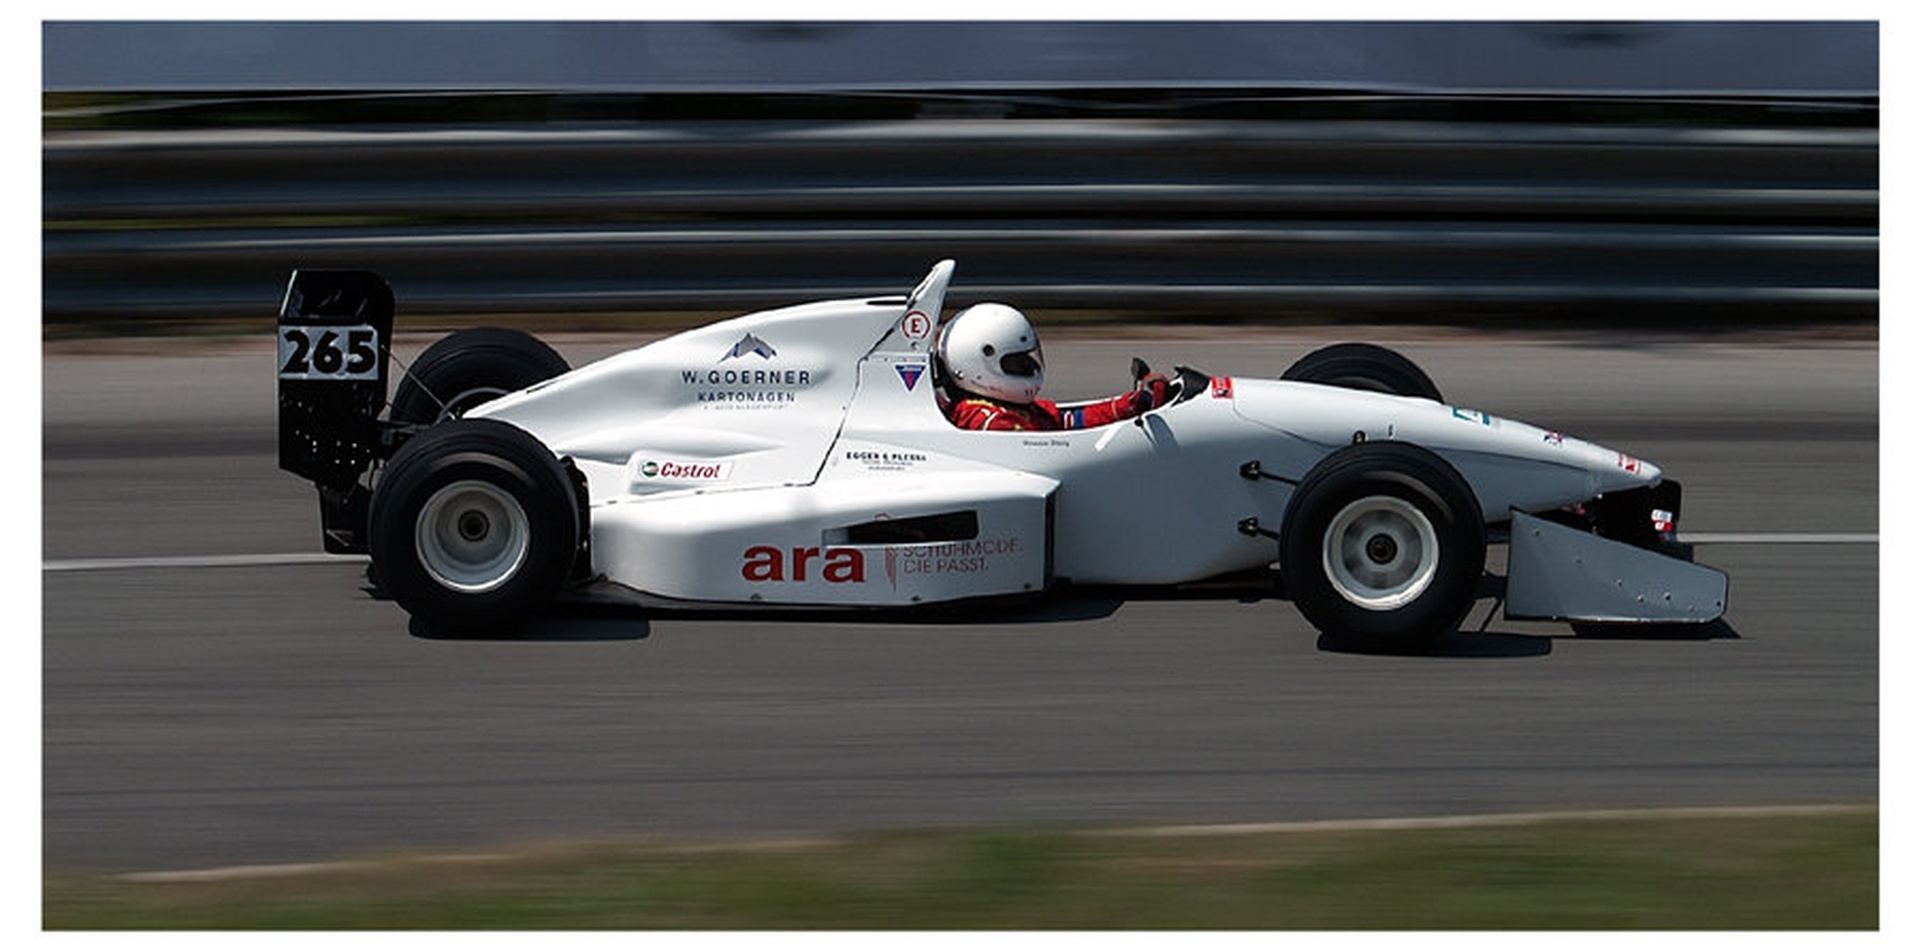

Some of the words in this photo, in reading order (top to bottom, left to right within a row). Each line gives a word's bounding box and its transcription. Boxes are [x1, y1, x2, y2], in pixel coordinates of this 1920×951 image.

[911, 318, 921, 333] E
[280, 329, 376, 374] 265
[698, 391, 795, 402] KARTONAGEN
[660, 462, 721, 478] Castrol
[742, 546, 866, 583] ara
[904, 560, 932, 574] DIE
